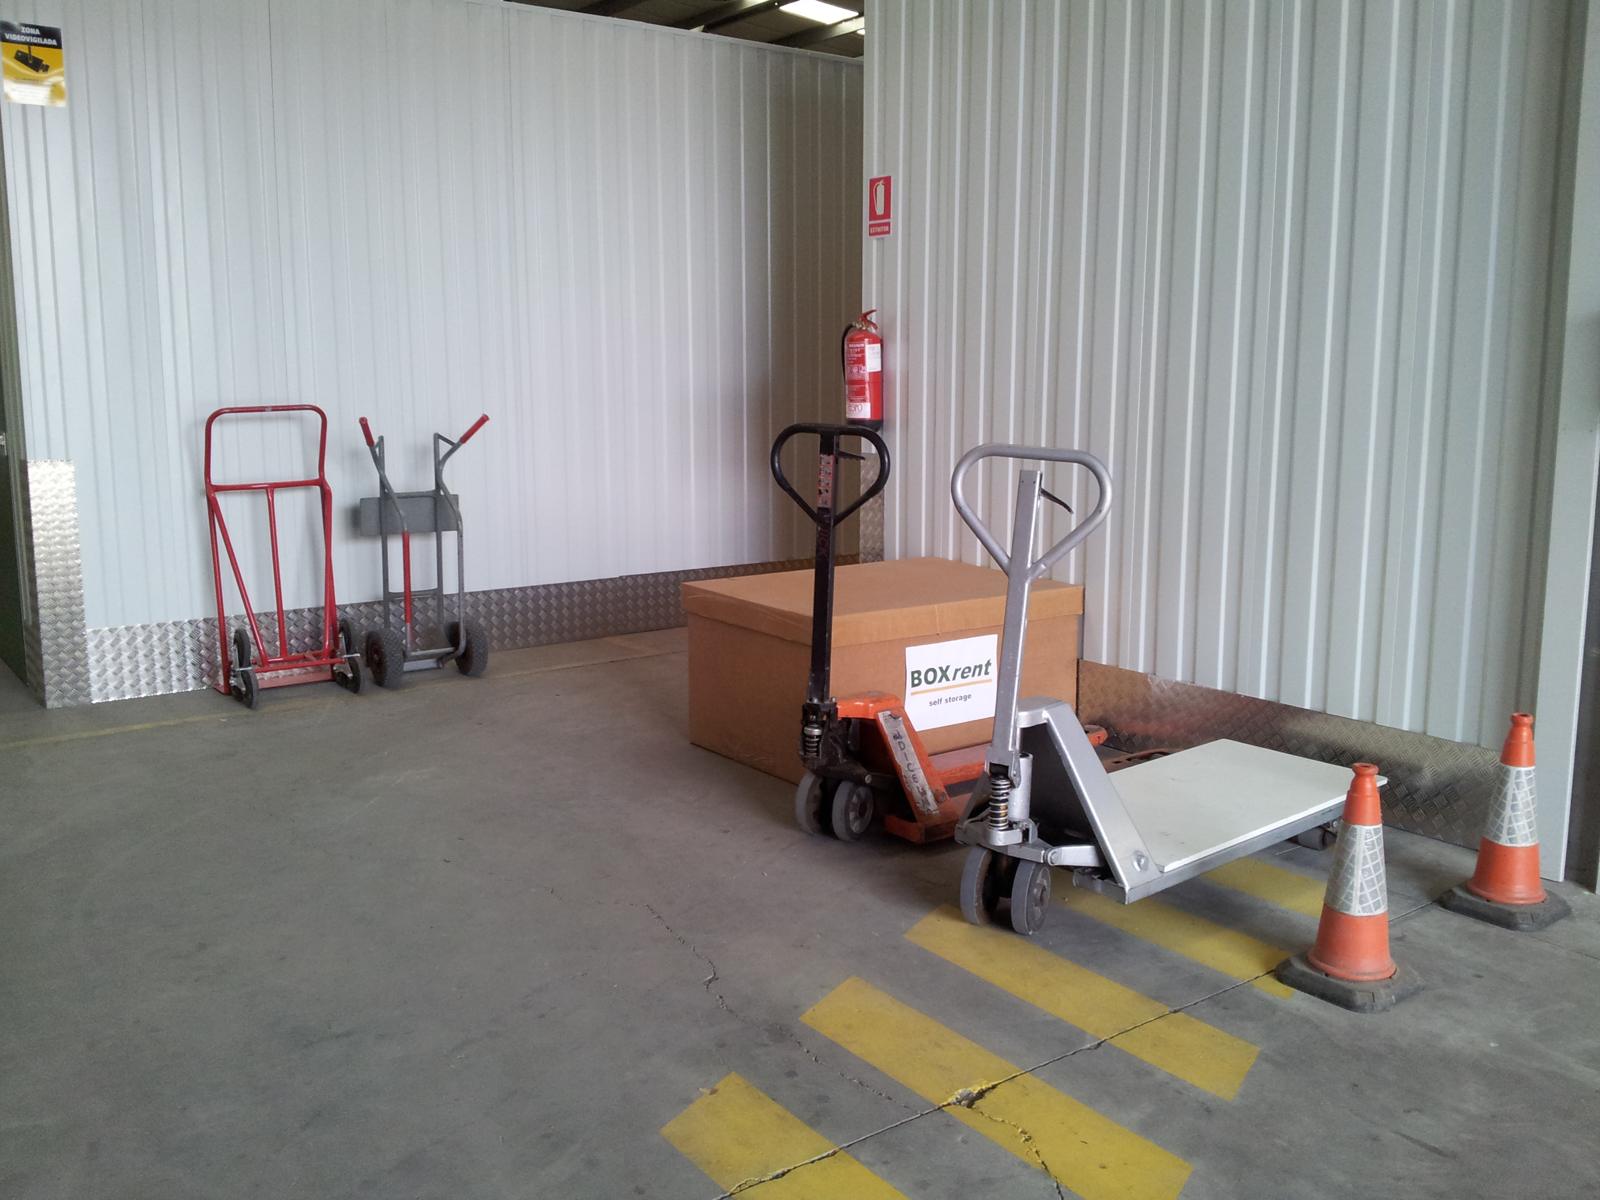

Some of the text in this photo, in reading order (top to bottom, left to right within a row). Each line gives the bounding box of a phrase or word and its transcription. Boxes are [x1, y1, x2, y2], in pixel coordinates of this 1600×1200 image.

[5, 33, 57, 45] VIDEOVIGILADA
[929, 693, 972, 707] self storage
